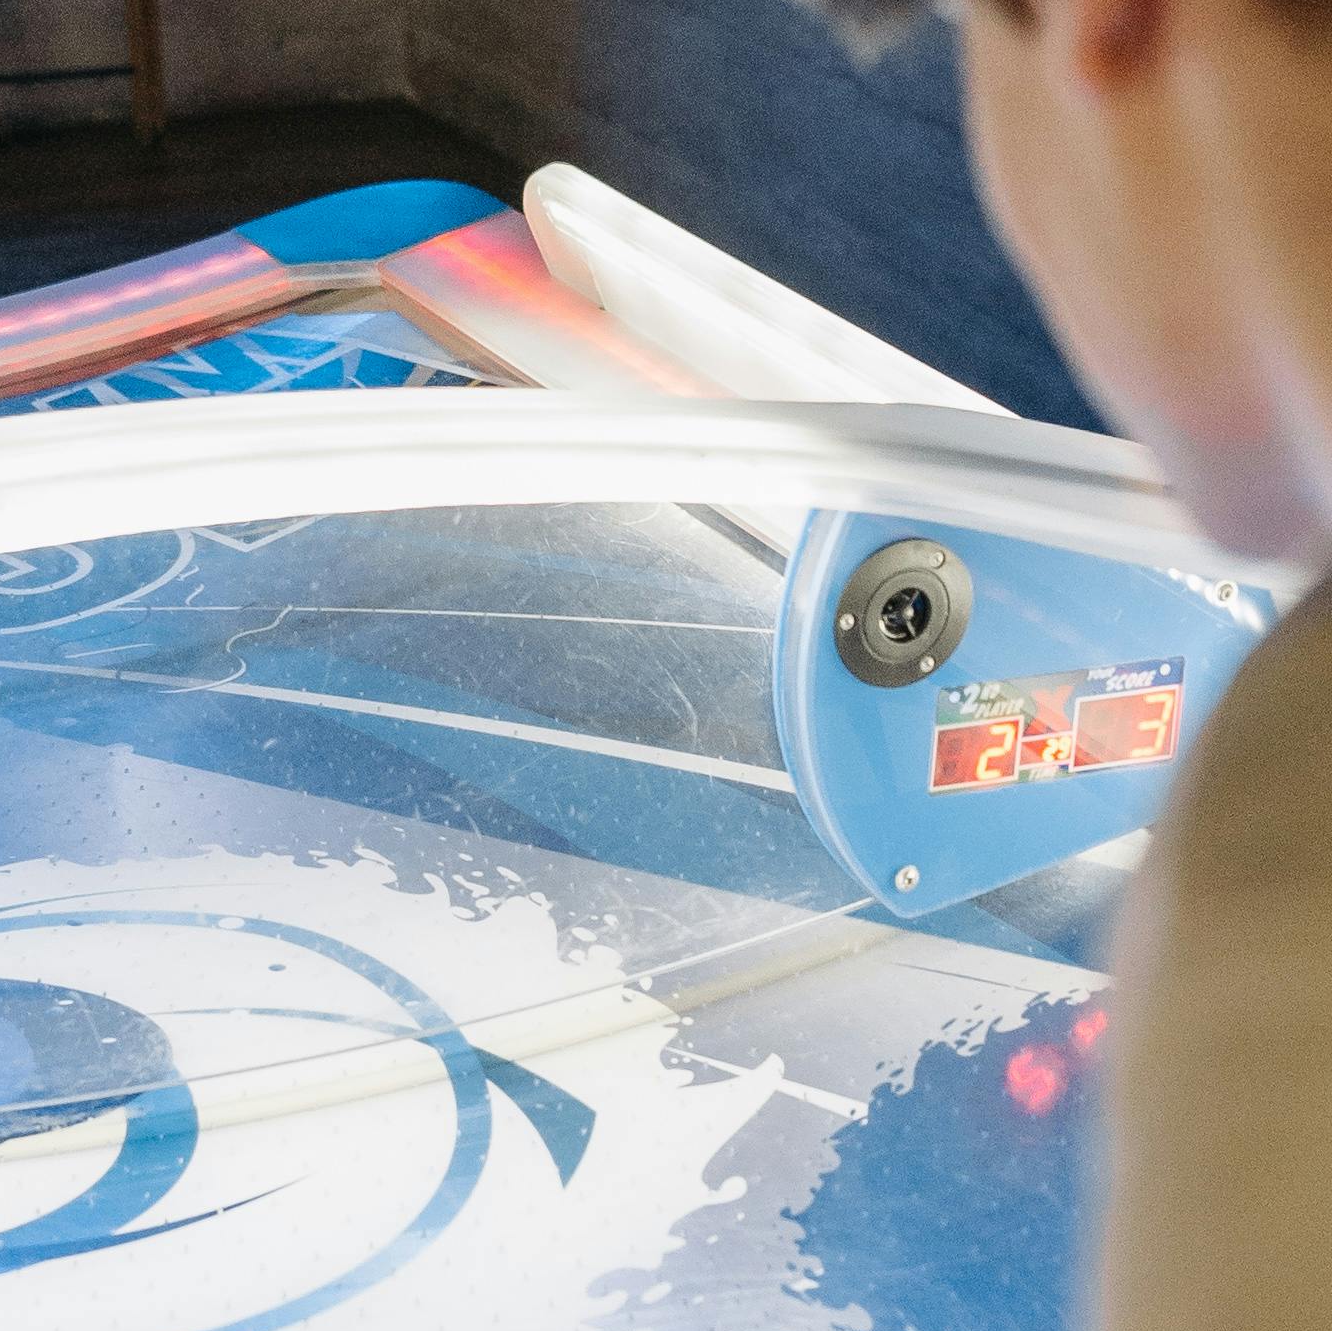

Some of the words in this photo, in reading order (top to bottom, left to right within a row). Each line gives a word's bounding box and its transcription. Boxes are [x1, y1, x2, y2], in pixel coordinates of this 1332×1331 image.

[1105, 670, 1157, 693] SCORE
[974, 698, 1025, 720] PLAYER
[1129, 692, 1175, 758] 3
[975, 723, 1017, 782] 2
[1041, 735, 1072, 763] 29
